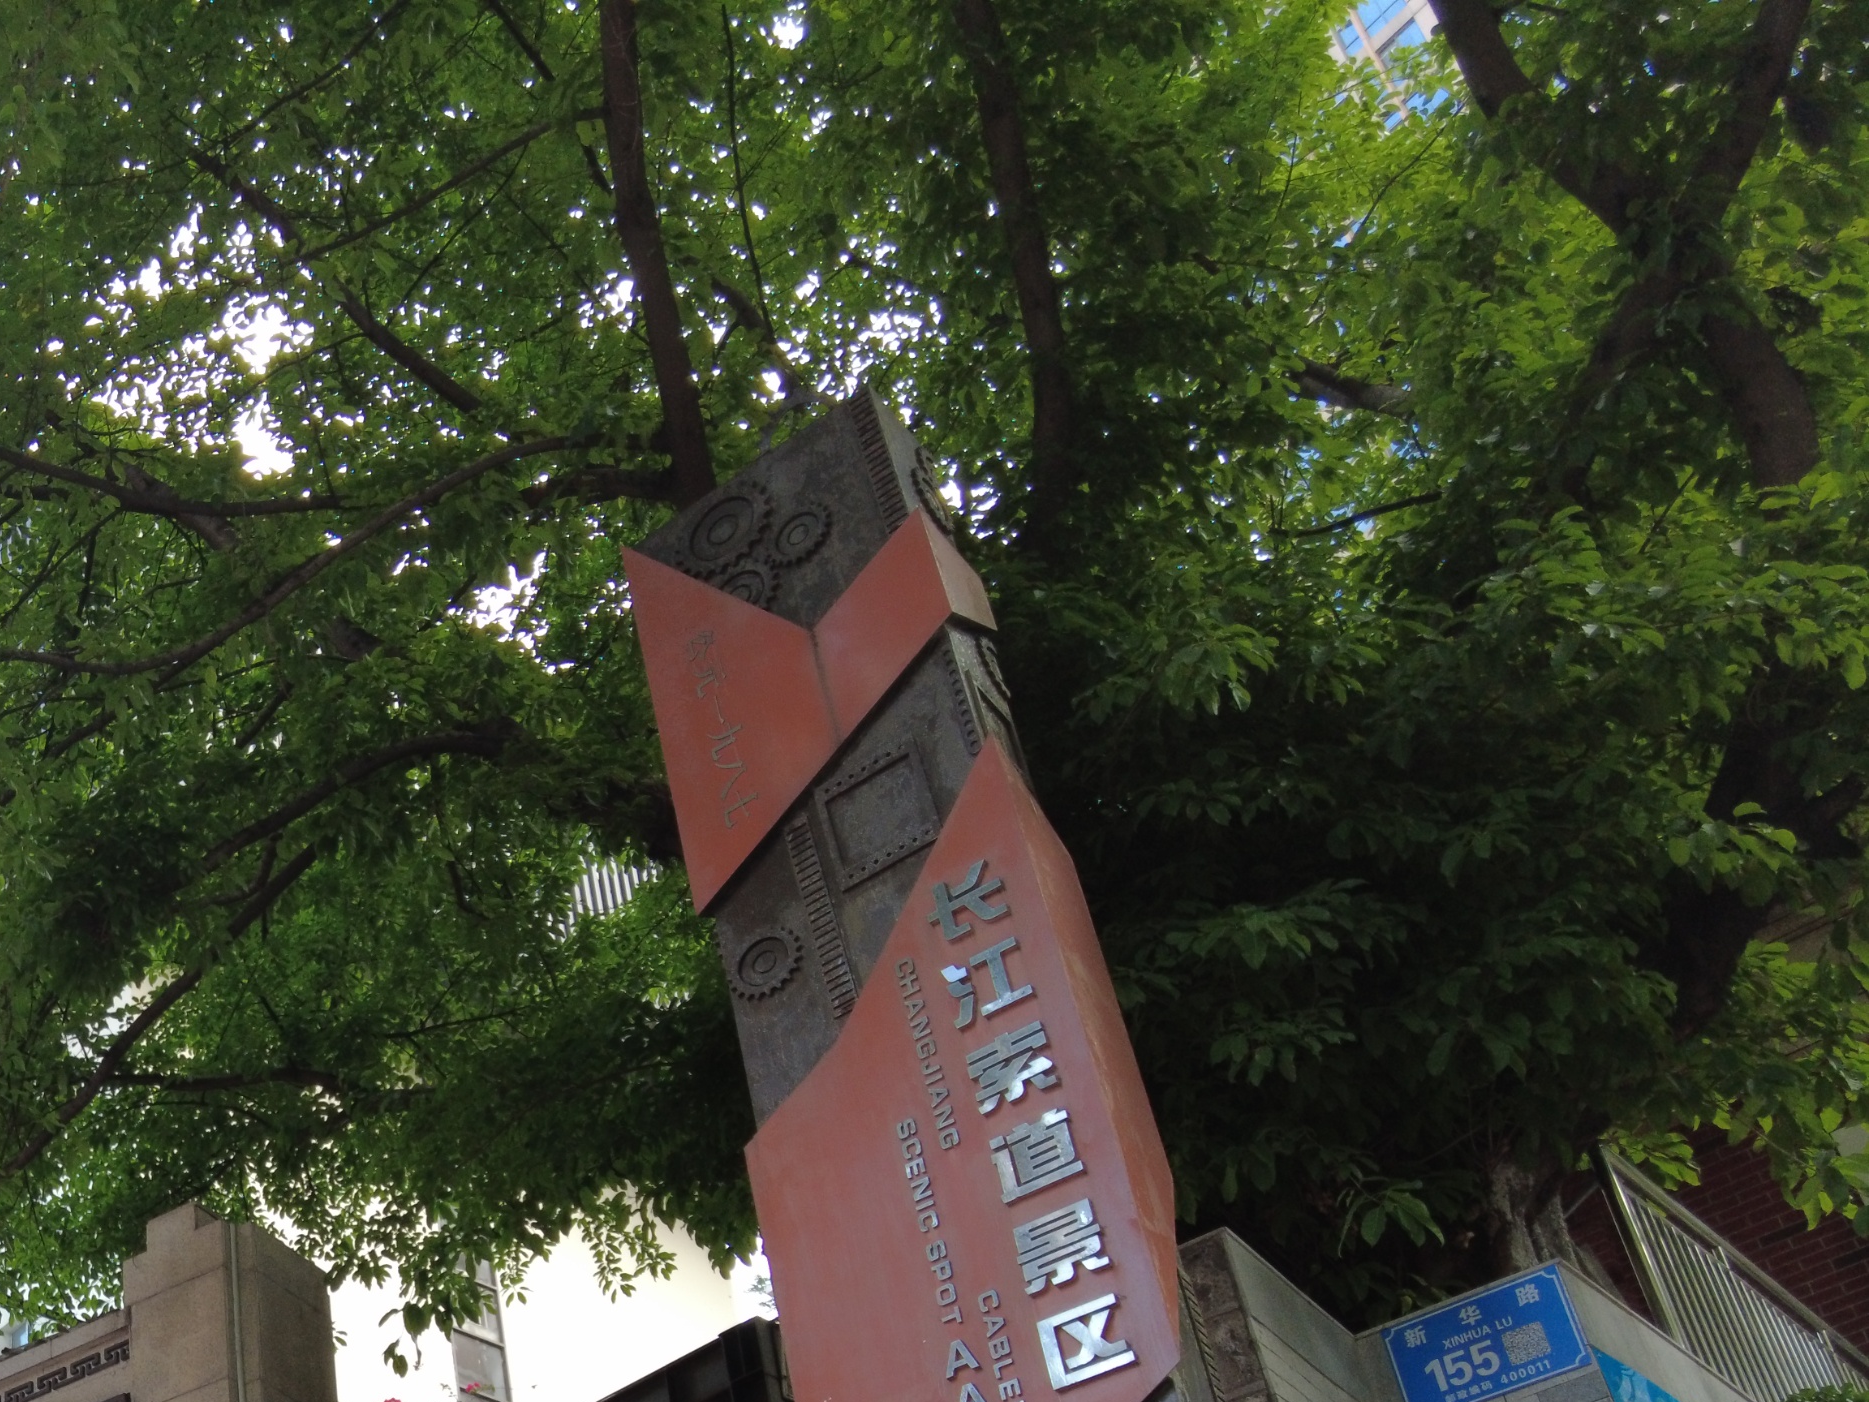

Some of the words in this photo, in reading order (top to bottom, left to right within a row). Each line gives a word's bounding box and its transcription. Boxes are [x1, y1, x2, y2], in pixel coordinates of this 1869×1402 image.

[895, 957, 961, 1151] CHANGJIANG
[929, 859, 1136, 1391] 长江索道景区
[896, 1117, 941, 1234] SCENIC
[925, 1239, 964, 1325] SPOT
[1404, 1283, 1540, 1348] 新华路
[1442, 1325, 1492, 1350] XINHUA
[1495, 1316, 1513, 1331] LU
[1424, 1340, 1500, 1392] 155
[1500, 1359, 1551, 1384] 400011
